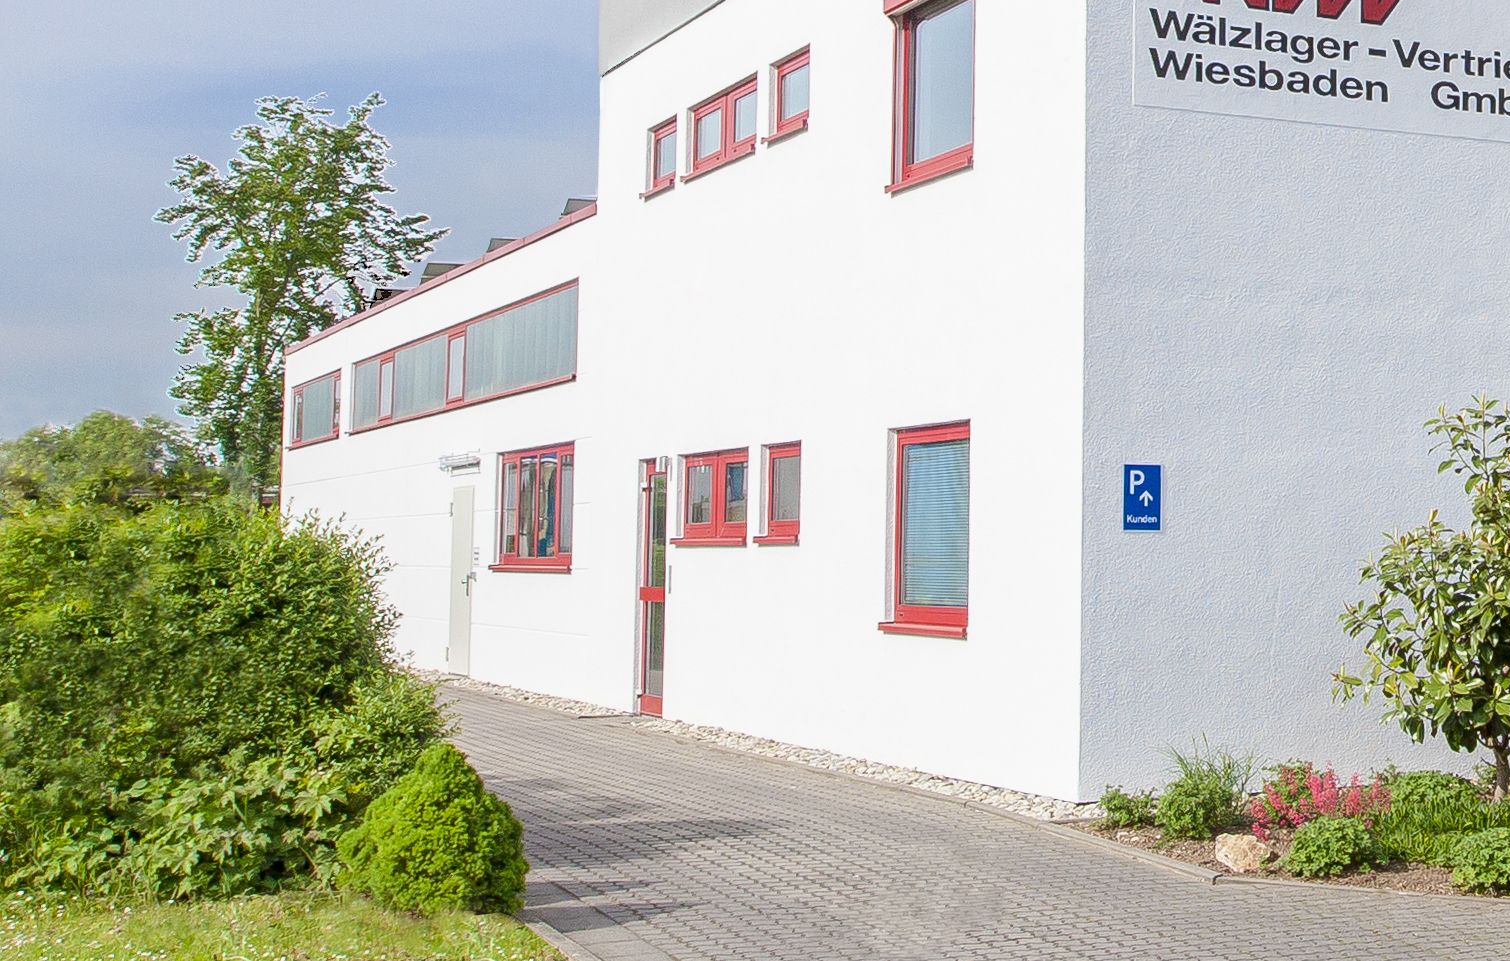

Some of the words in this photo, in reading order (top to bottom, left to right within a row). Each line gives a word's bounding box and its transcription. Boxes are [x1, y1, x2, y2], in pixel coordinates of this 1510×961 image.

[1149, 48, 1388, 102] Wiesbaden
[1129, 469, 1145, 495] P
[1126, 514, 1157, 523] Kunden
